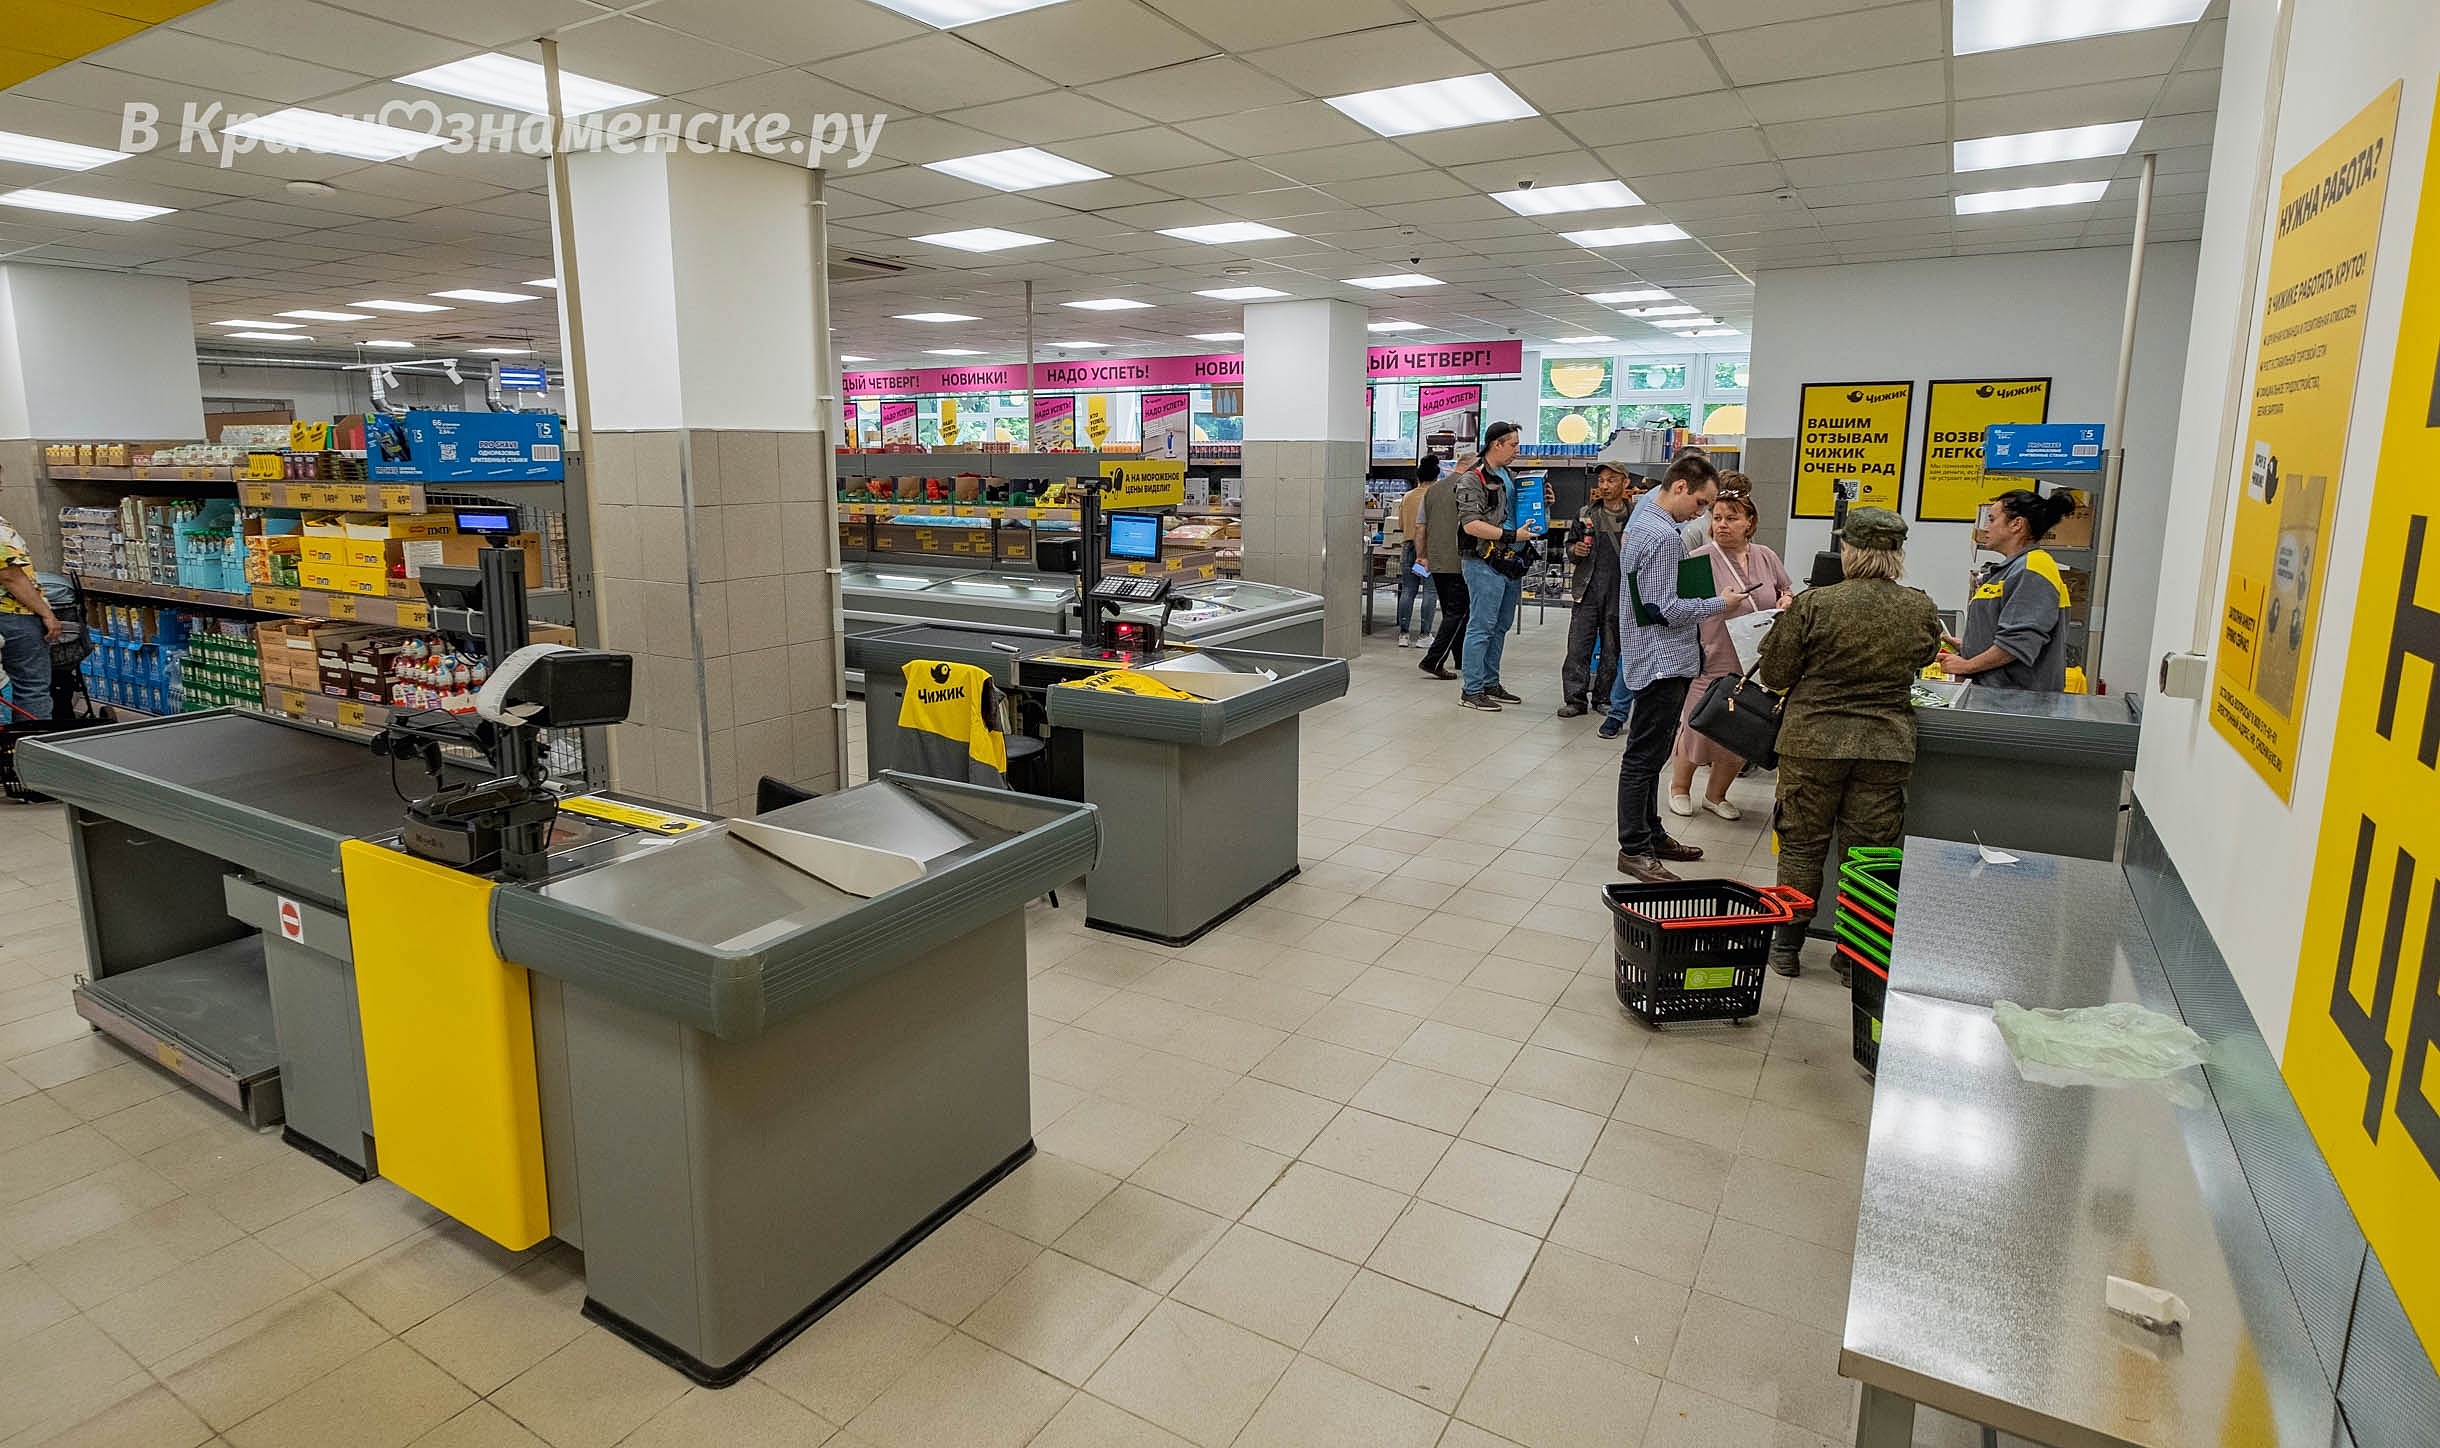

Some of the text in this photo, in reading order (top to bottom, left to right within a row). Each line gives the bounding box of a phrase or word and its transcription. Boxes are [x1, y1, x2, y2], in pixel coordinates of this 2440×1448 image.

[2278, 137, 2384, 240] НУЖНА РАБОТА?
[2273, 284, 2299, 313] ЧИЖИКЕ
[2299, 267, 2334, 302] РАБОТАТЬ
[2334, 250, 2368, 288] КРУТО!
[1367, 350, 1492, 372] ЫЙ ЧЕТВЕРГ!
[941, 371, 1008, 387] НОВИНКИ!
[1047, 367, 1087, 383] НАДО
[1091, 364, 1149, 381] УСПЕТЬ!
[869, 375, 920, 390] ЧЕТВЕРГ!
[1866, 389, 1907, 404] Чижик
[1997, 384, 2042, 399] Чижик
[1422, 389, 1477, 411] НАДО УСПЕТЬ!
[1034, 407, 1050, 418] НАДО
[1050, 402, 1072, 414] УСПЕТЬ!
[1145, 406, 1162, 418] НАДО
[1163, 398, 1186, 412] УСПЕТЬ!
[1807, 417, 1872, 428] ВАШИМ
[1806, 432, 1889, 444] ОТЗЫВАМ
[1805, 447, 1865, 459] ЧИЖИК
[1803, 462, 1896, 476] ОЧЕНЬ РАД
[1125, 472, 1179, 482] А НА МОРОЖЕНОЕ
[1126, 483, 1171, 495] ЦЕНЫ ВИДЕЛИ?
[918, 686, 966, 704] Чижик
